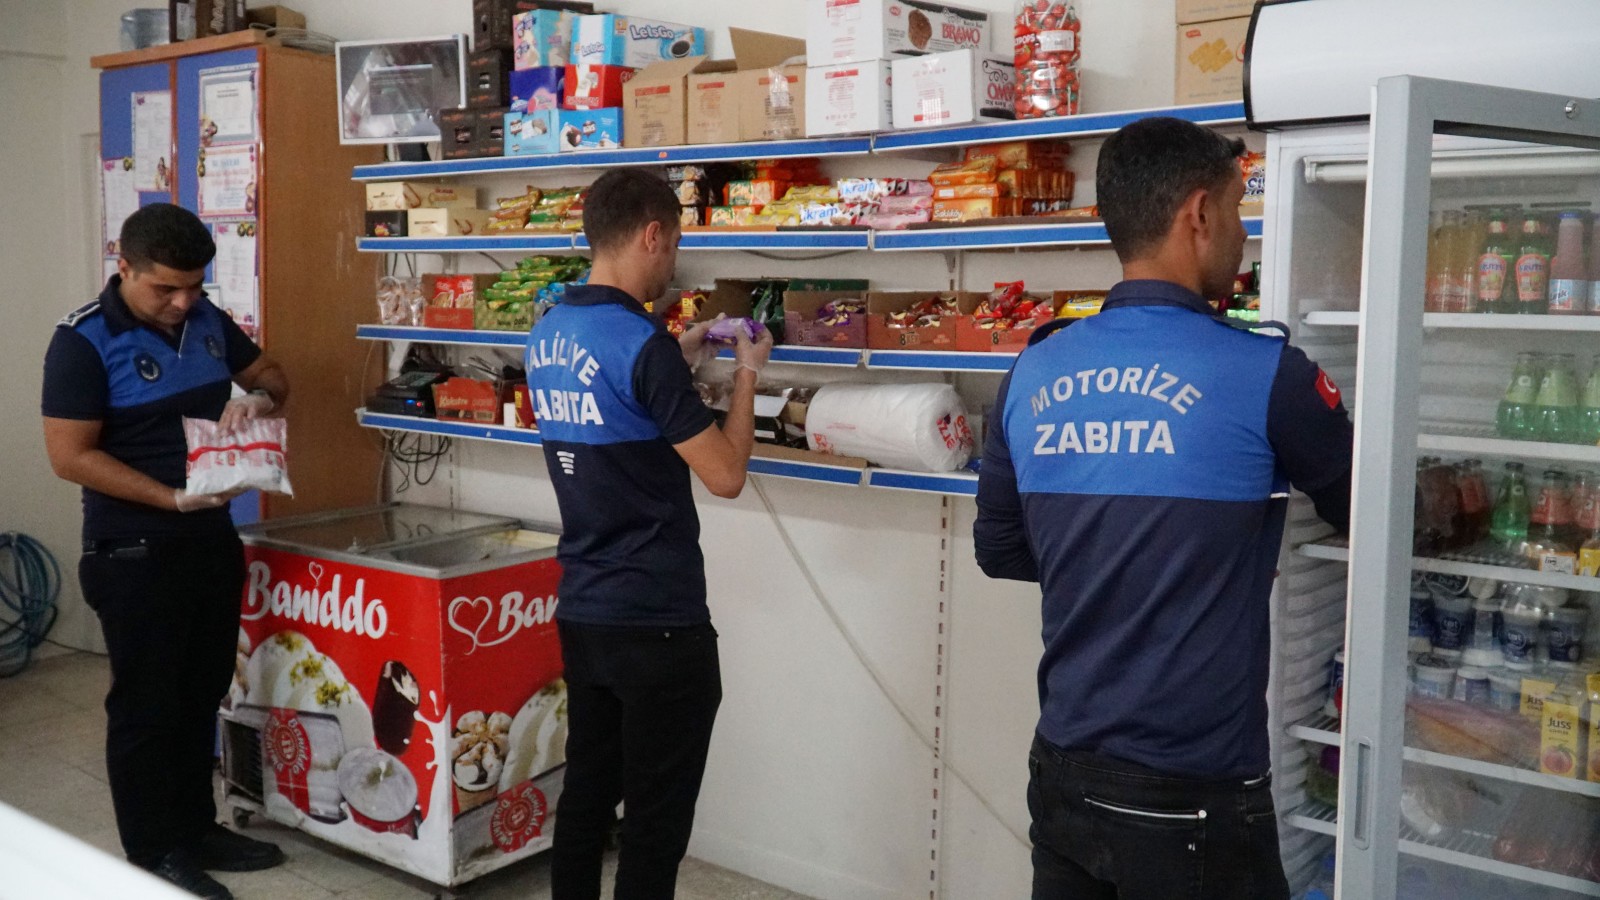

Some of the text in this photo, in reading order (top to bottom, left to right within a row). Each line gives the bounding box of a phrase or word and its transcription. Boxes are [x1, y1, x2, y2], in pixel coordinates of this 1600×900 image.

[629, 24, 675, 41] LetsGo
[526, 331, 600, 386] ALİLİYE
[1031, 363, 1203, 416] MOTORİZE
[1034, 420, 1175, 455] ZABITA
[240, 561, 387, 639] Baniddo
